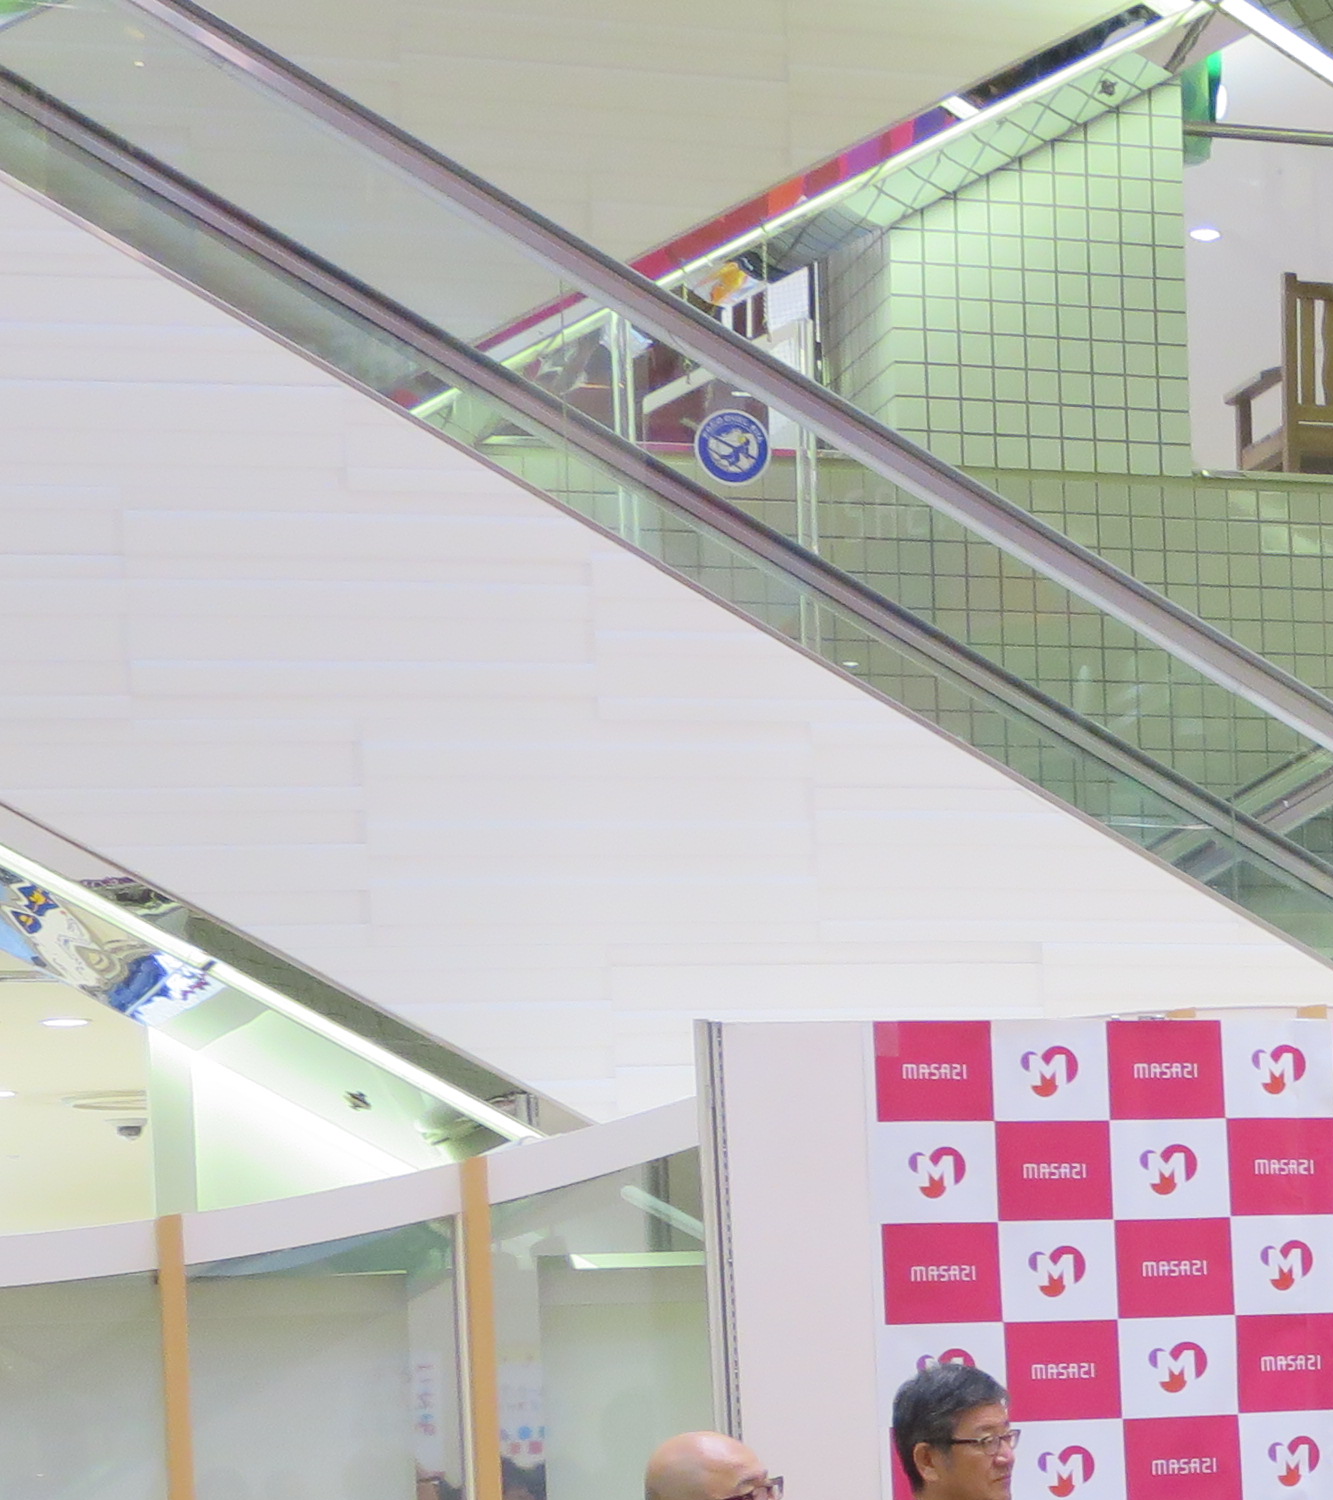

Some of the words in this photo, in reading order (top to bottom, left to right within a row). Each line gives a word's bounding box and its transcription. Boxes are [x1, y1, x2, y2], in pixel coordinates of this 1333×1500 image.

[901, 1063, 968, 1080] MASA21
[1133, 1062, 1199, 1080] MASA21
[1022, 1162, 1087, 1180] MASA21
[1254, 1158, 1315, 1176] MASA21
[910, 1264, 977, 1282] MASA21
[1141, 1259, 1208, 1278] MASA21
[1030, 1362, 1096, 1380] MASA21
[1260, 1354, 1322, 1372] MASA21
[1151, 1457, 1218, 1476] MASA21
